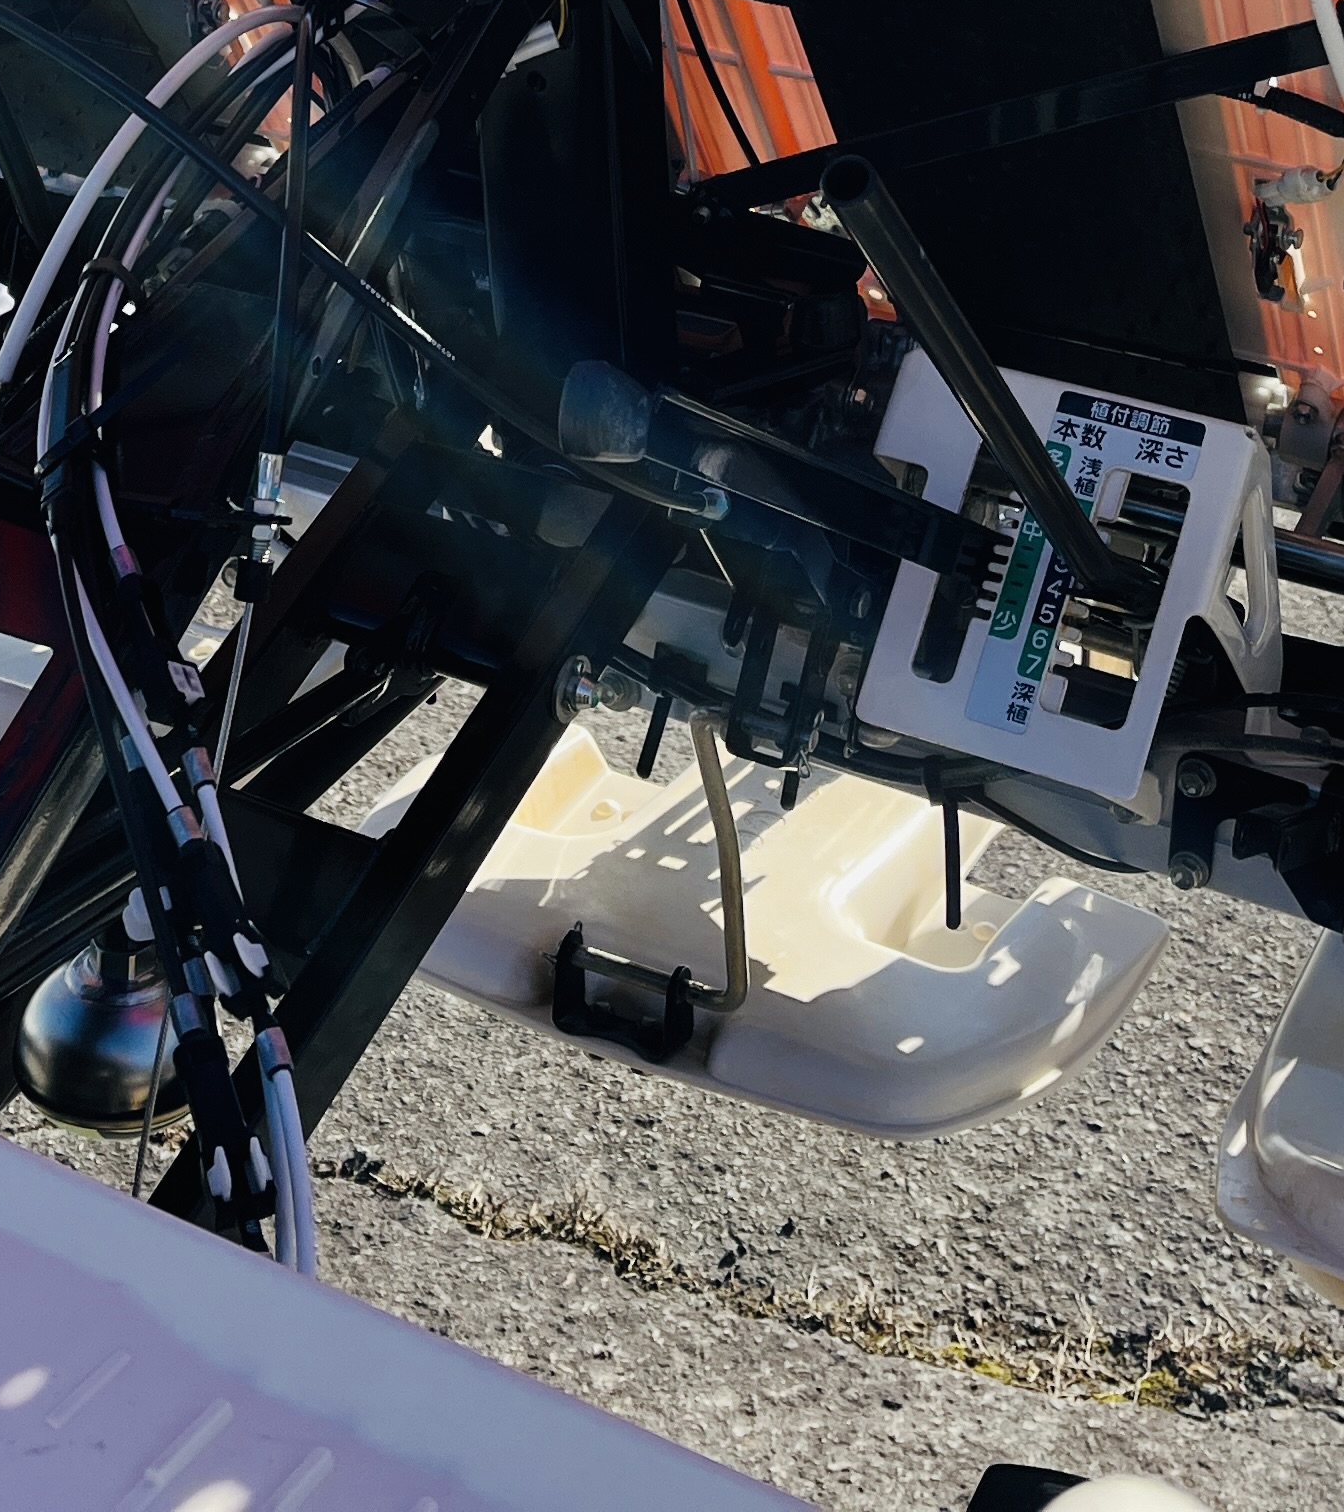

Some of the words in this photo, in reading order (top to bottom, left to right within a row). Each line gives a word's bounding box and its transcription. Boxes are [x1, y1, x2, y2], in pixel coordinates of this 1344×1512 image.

[1090, 400, 1171, 435] 植付調節
[1054, 418, 1107, 450] 本数
[1135, 437, 1188, 468] 深さ
[1074, 456, 1103, 497] 浅植
[1021, 520, 1043, 542] 中
[1046, 580, 1062, 599] 4
[994, 610, 1017, 631] 少
[1039, 604, 1055, 623] 5
[1032, 630, 1049, 649] 6
[1026, 654, 1042, 674] 7
[1007, 681, 1036, 725] 深植
